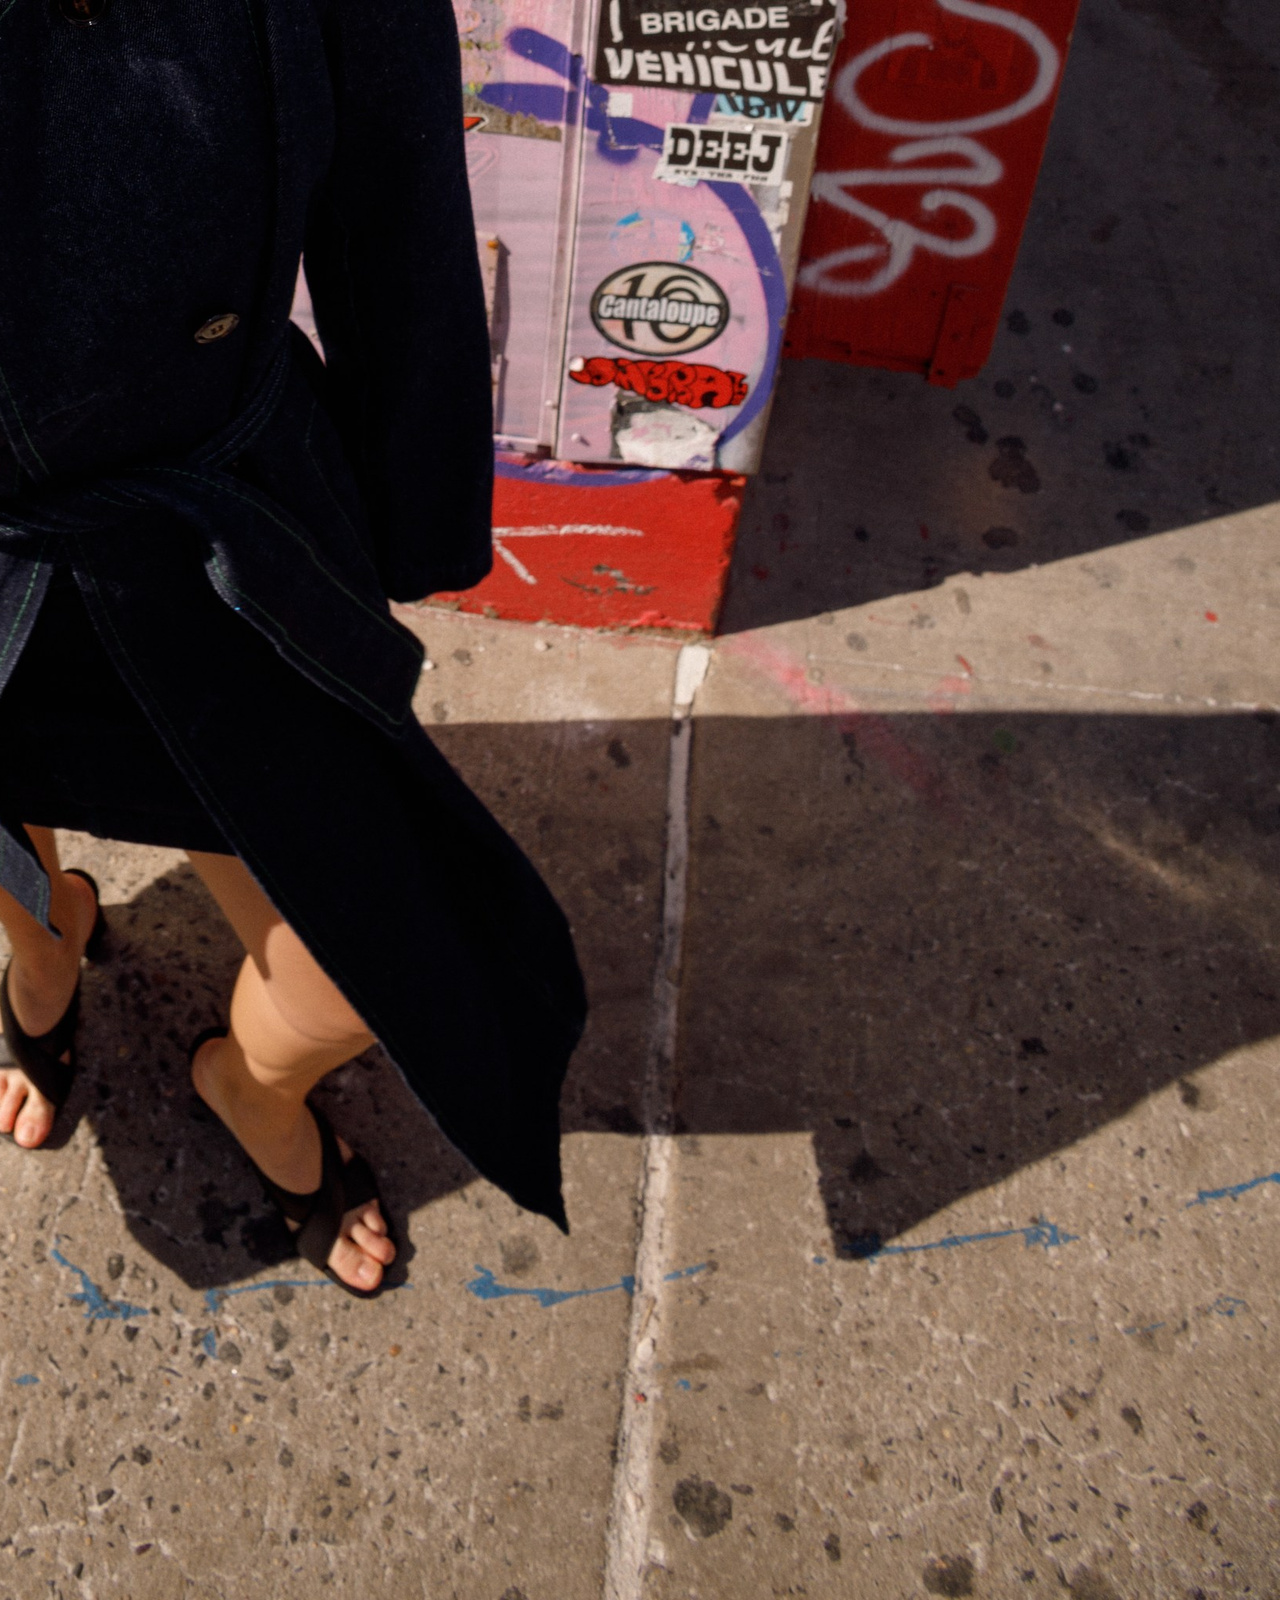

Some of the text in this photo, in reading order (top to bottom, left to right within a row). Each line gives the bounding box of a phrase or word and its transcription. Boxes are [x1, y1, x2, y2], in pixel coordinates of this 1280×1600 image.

[640, 6, 790, 34] BRIGADE
[667, 127, 783, 173] DEEJ
[598, 294, 721, 328] Cantaloupe
